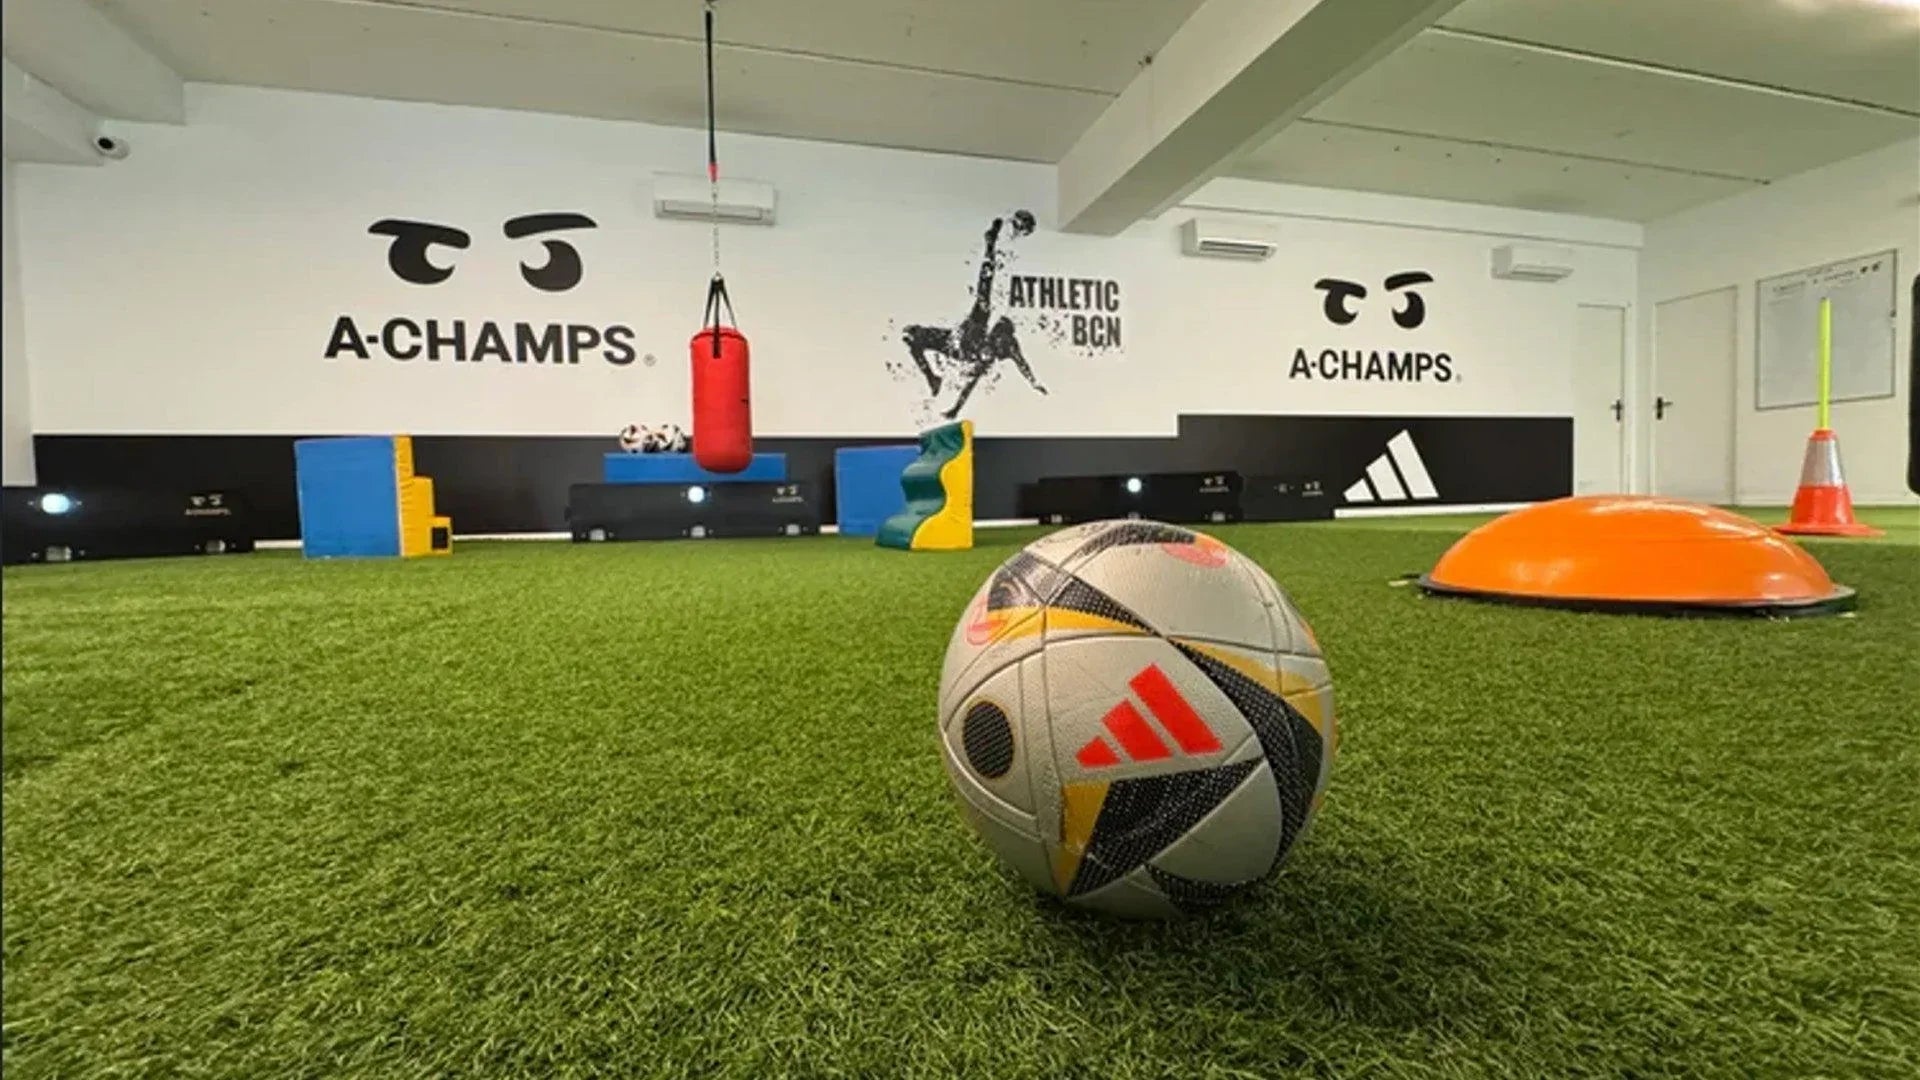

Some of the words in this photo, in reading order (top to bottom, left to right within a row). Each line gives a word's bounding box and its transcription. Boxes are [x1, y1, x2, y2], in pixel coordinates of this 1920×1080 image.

[1008, 275, 1120, 312] ATHLETIC
[324, 316, 637, 366] A-CHAMPS
[1072, 314, 1121, 347] BCN
[1289, 347, 1453, 383] A-CHAMPS
